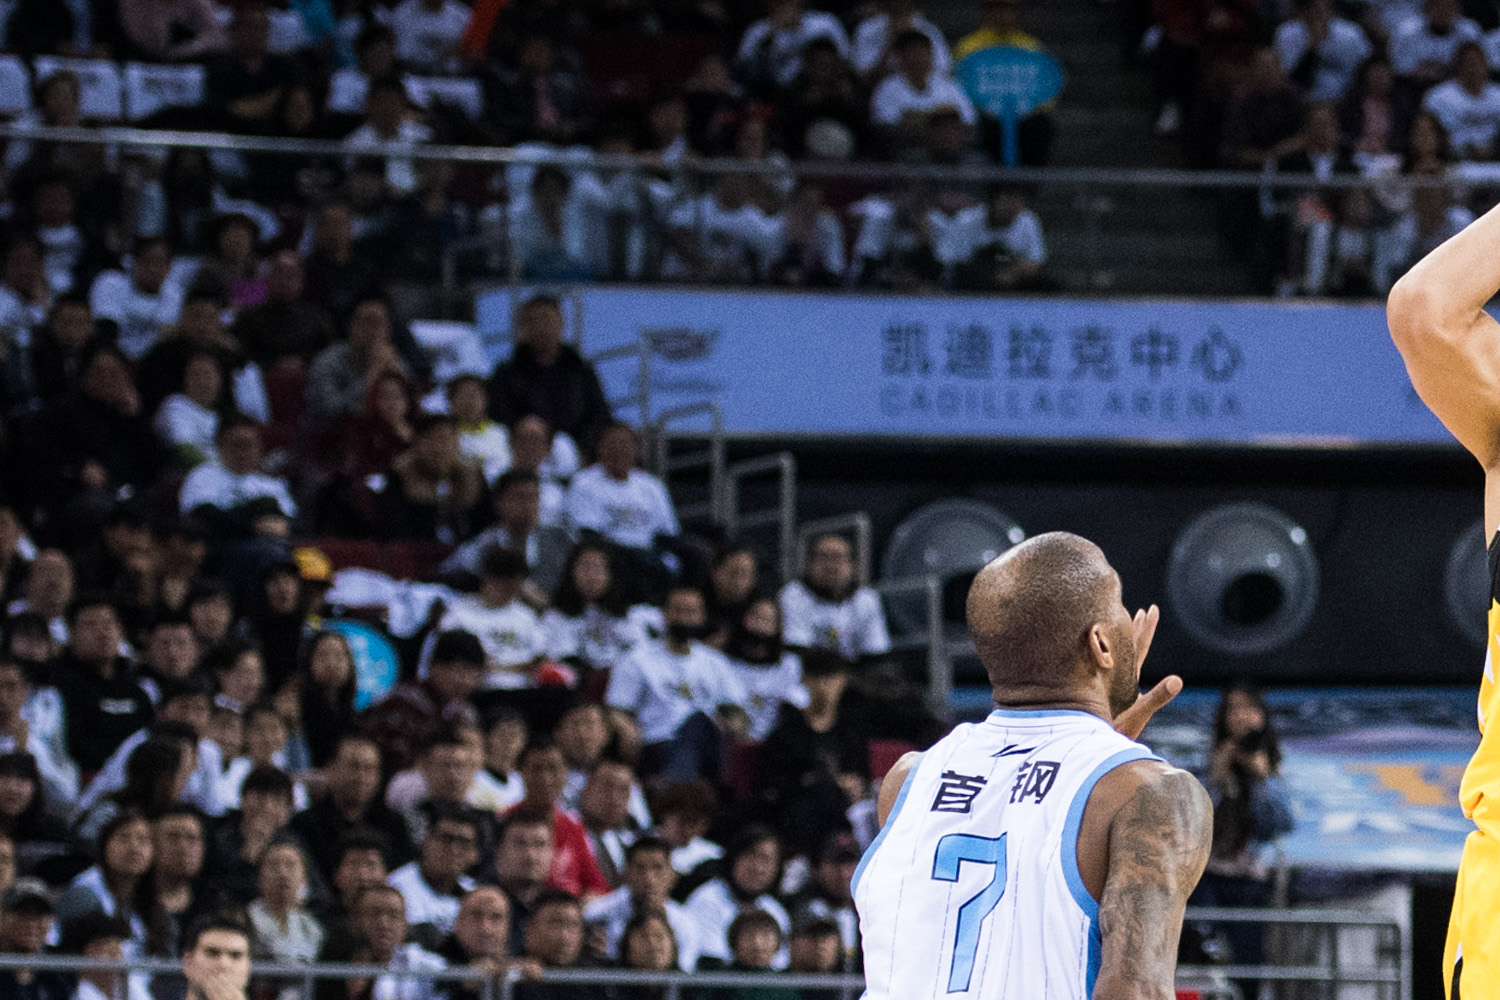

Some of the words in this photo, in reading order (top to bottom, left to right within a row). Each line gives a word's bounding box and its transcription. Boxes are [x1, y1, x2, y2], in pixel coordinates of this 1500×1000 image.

[880, 322, 1244, 383] 凯迪拉克中心
[880, 386, 1080, 419] CADILLAC
[1102, 388, 1243, 419] ARENA
[930, 759, 1061, 814] 首钢
[931, 831, 1007, 994] 7
